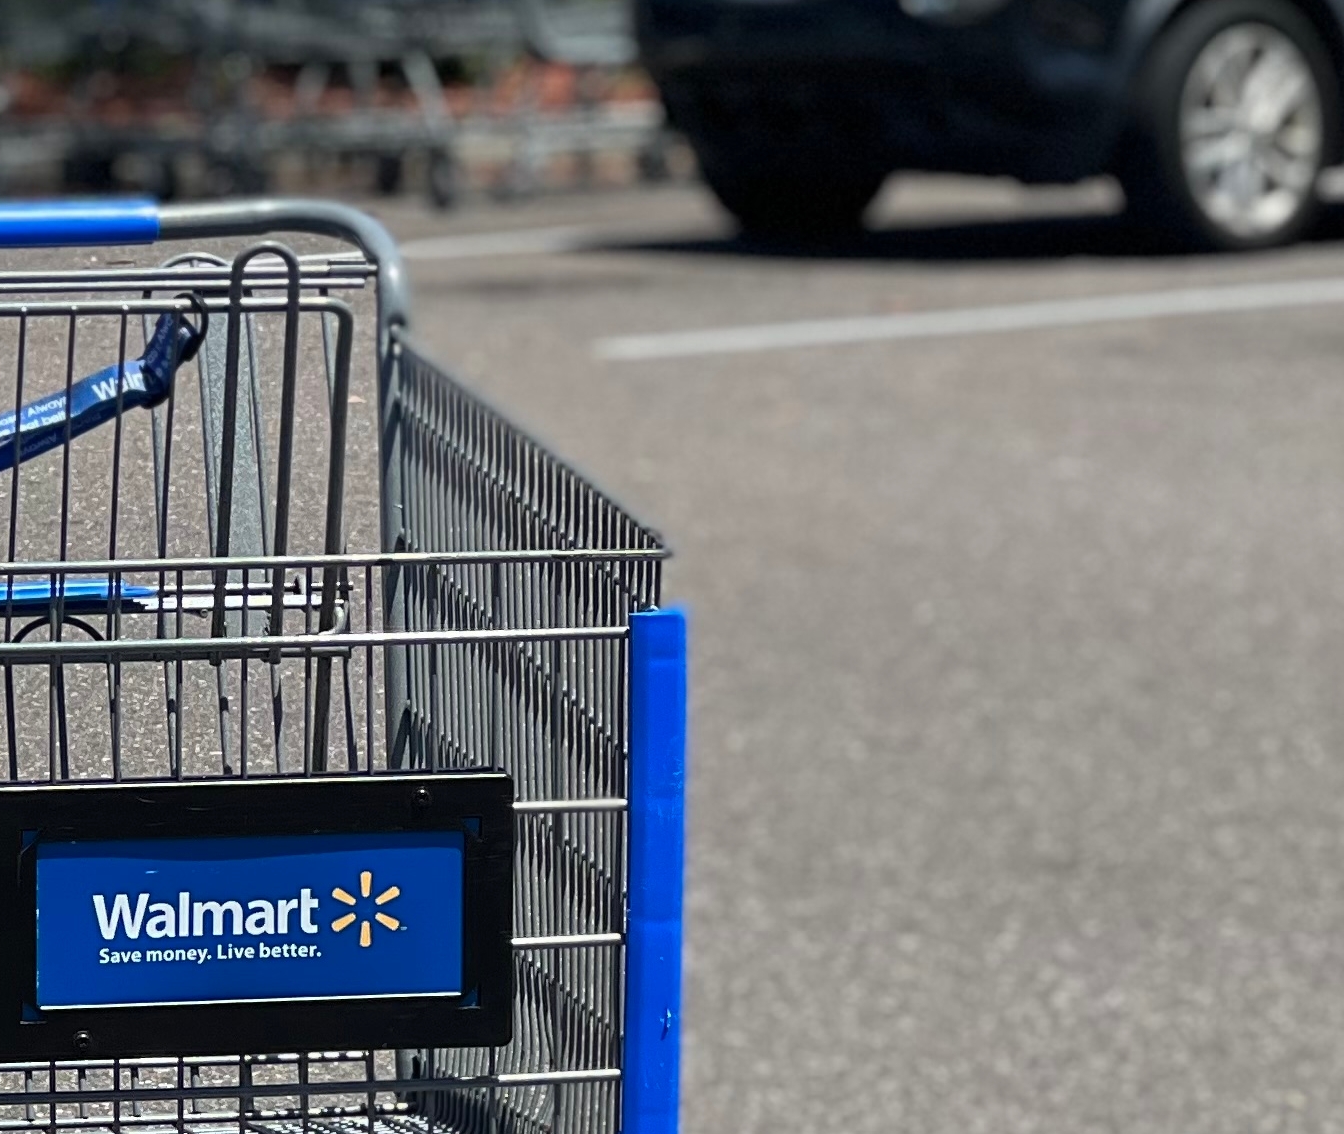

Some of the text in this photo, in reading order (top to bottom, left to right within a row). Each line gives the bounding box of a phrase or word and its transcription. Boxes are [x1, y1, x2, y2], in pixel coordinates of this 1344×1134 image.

[92, 888, 319, 940] Walmart
[99, 942, 322, 964] Save money. Live better.
